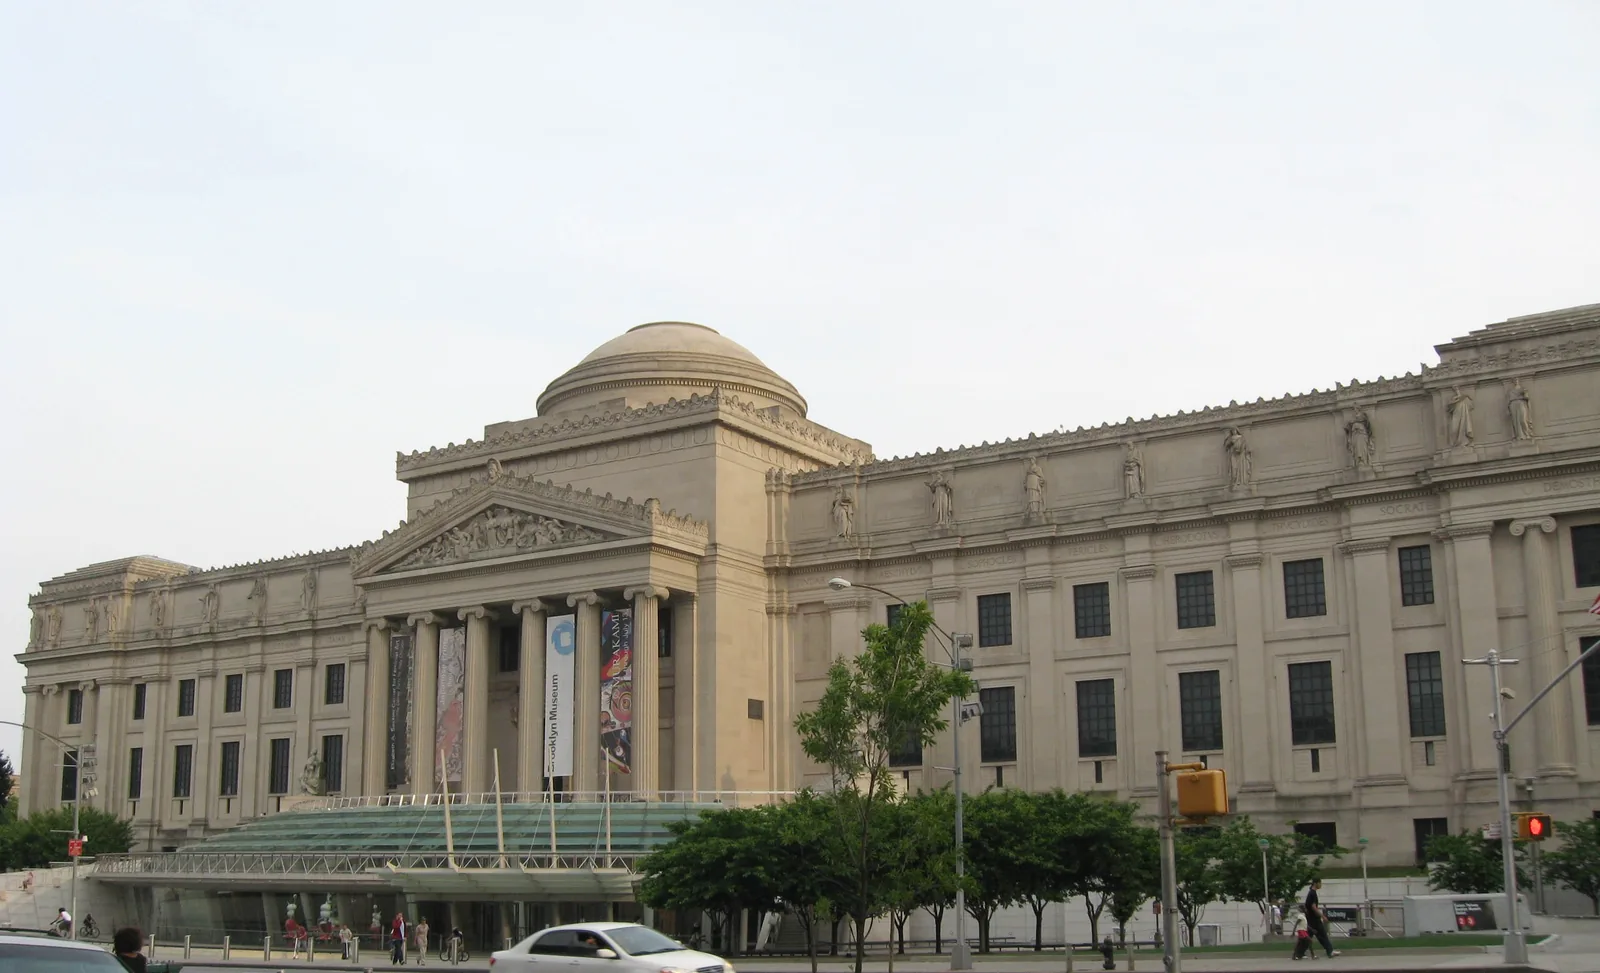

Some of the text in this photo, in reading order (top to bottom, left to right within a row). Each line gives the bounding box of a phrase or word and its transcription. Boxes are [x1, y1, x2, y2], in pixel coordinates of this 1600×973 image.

[621, 623, 630, 639] July
[611, 614, 620, 688] MURAKAMI
[549, 674, 558, 721] Museum
[1326, 910, 1347, 920] Subway
